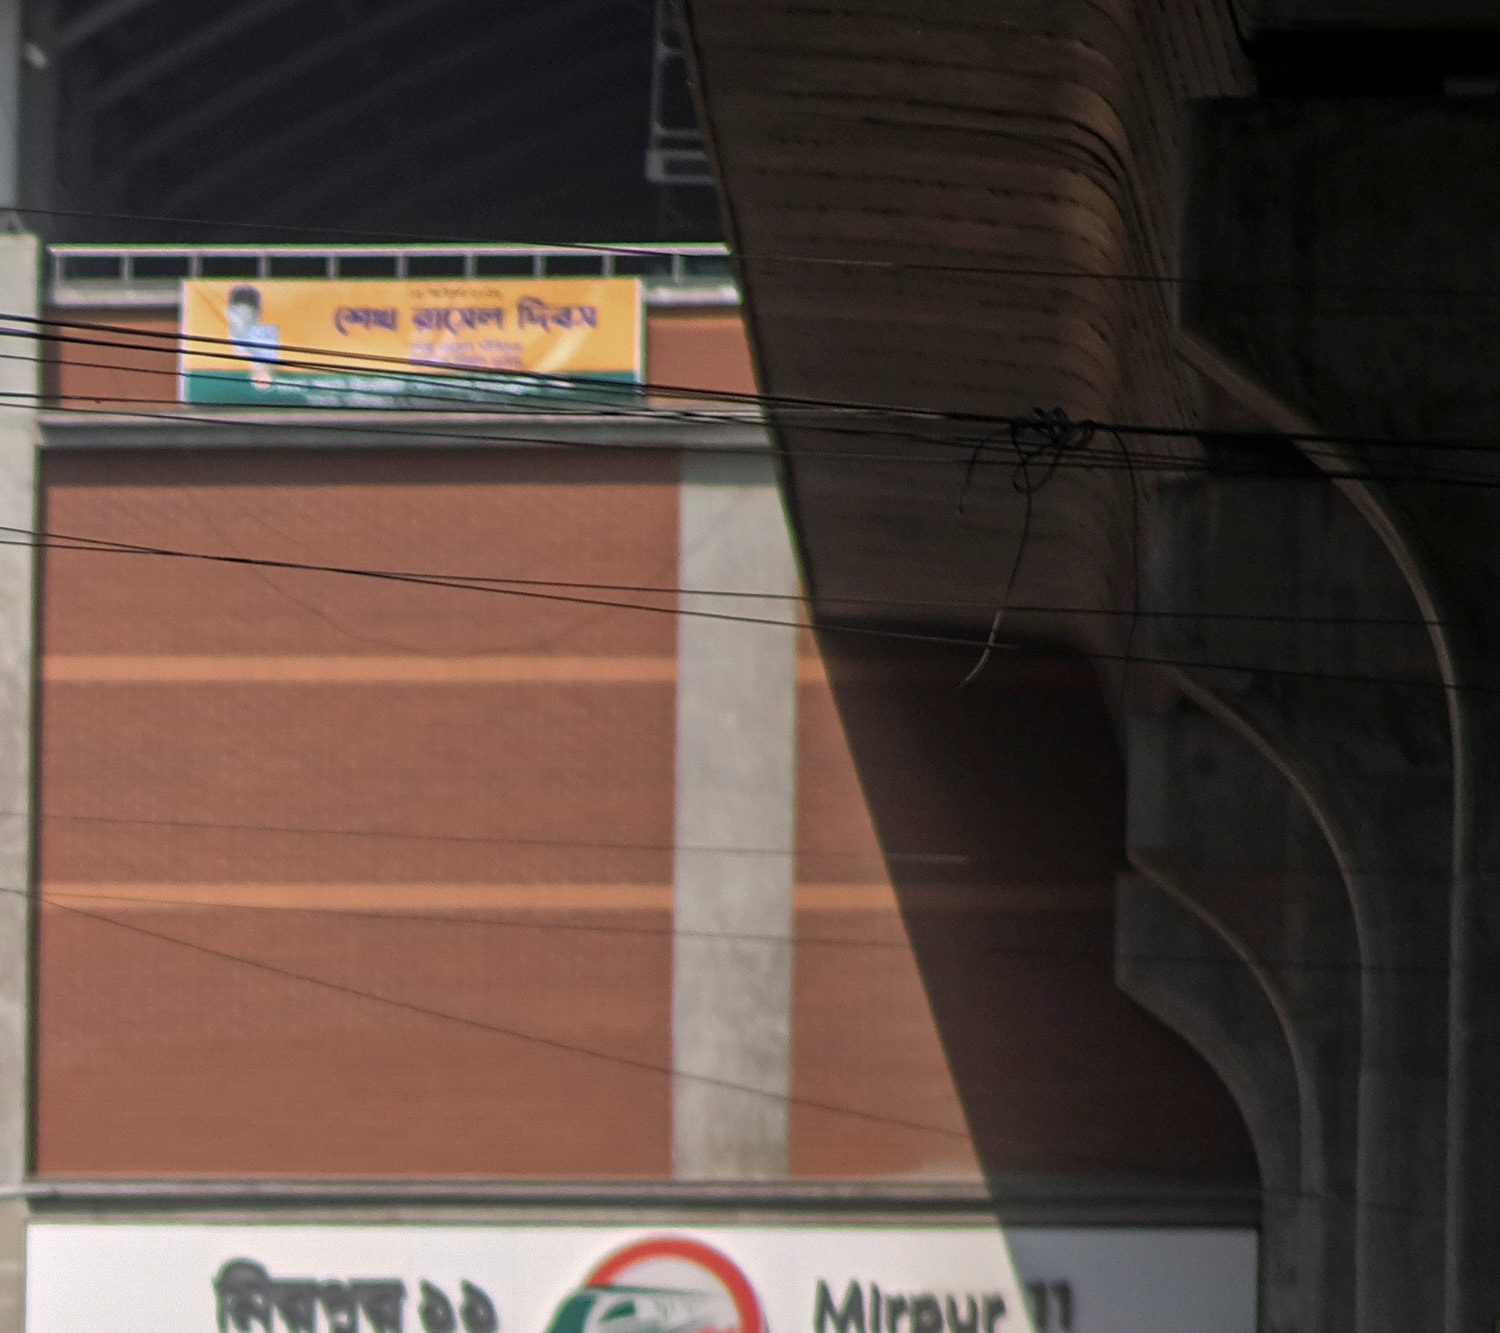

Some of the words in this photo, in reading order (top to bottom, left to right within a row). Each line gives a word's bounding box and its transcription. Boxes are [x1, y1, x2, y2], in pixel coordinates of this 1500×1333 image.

[334, 306, 397, 336] শেখ
[411, 306, 504, 336] রাসেল
[517, 294, 598, 332] দিবস
